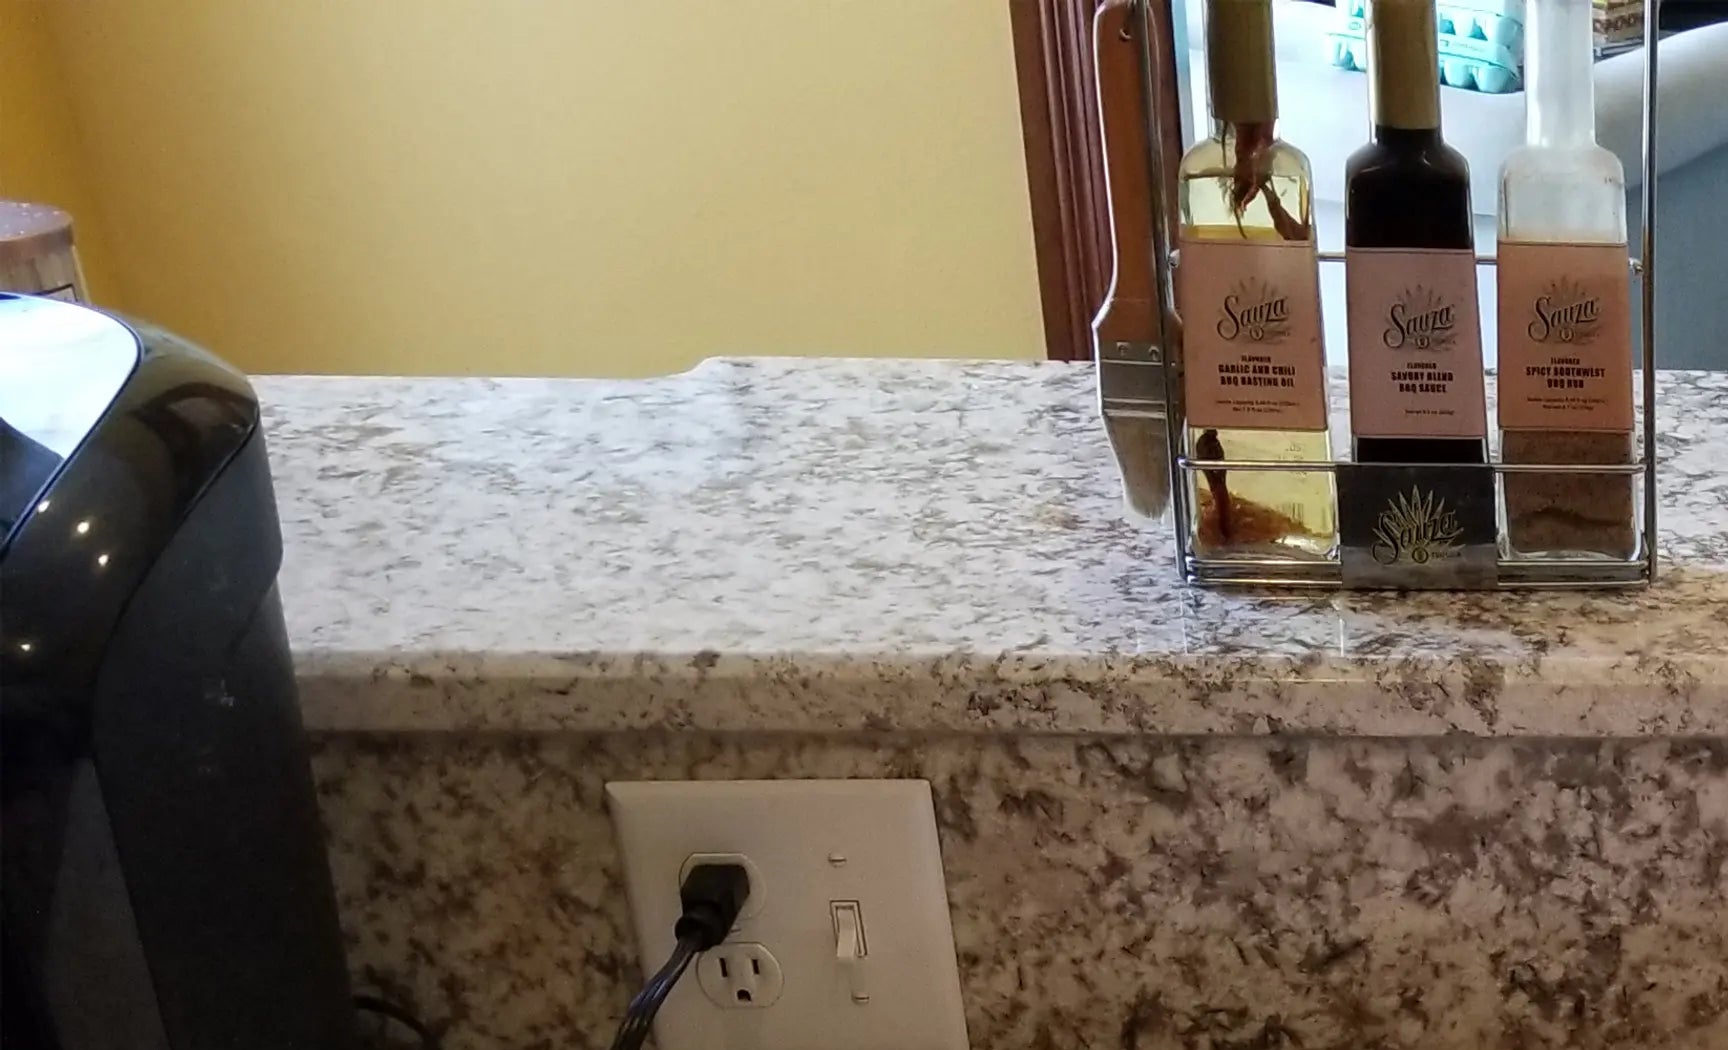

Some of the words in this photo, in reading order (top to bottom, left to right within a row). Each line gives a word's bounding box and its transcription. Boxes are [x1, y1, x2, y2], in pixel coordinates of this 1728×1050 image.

[1216, 294, 1290, 341] Sauza
[1527, 296, 1600, 343] Sauza
[1383, 303, 1456, 349] Sauza
[1218, 364, 1250, 374] GARLIC
[1252, 364, 1270, 375] AND
[1272, 366, 1296, 376] CHILI
[1391, 371, 1425, 381] SAVORY
[1525, 366, 1552, 377] SPICY
[1553, 366, 1606, 378] SOUTHWEST
[1220, 376, 1239, 387] BBQ
[1281, 377, 1295, 388] OIL
[1399, 383, 1417, 393] BBQ
[1418, 383, 1447, 393] SAUCE
[1371, 510, 1459, 565] Sauza
